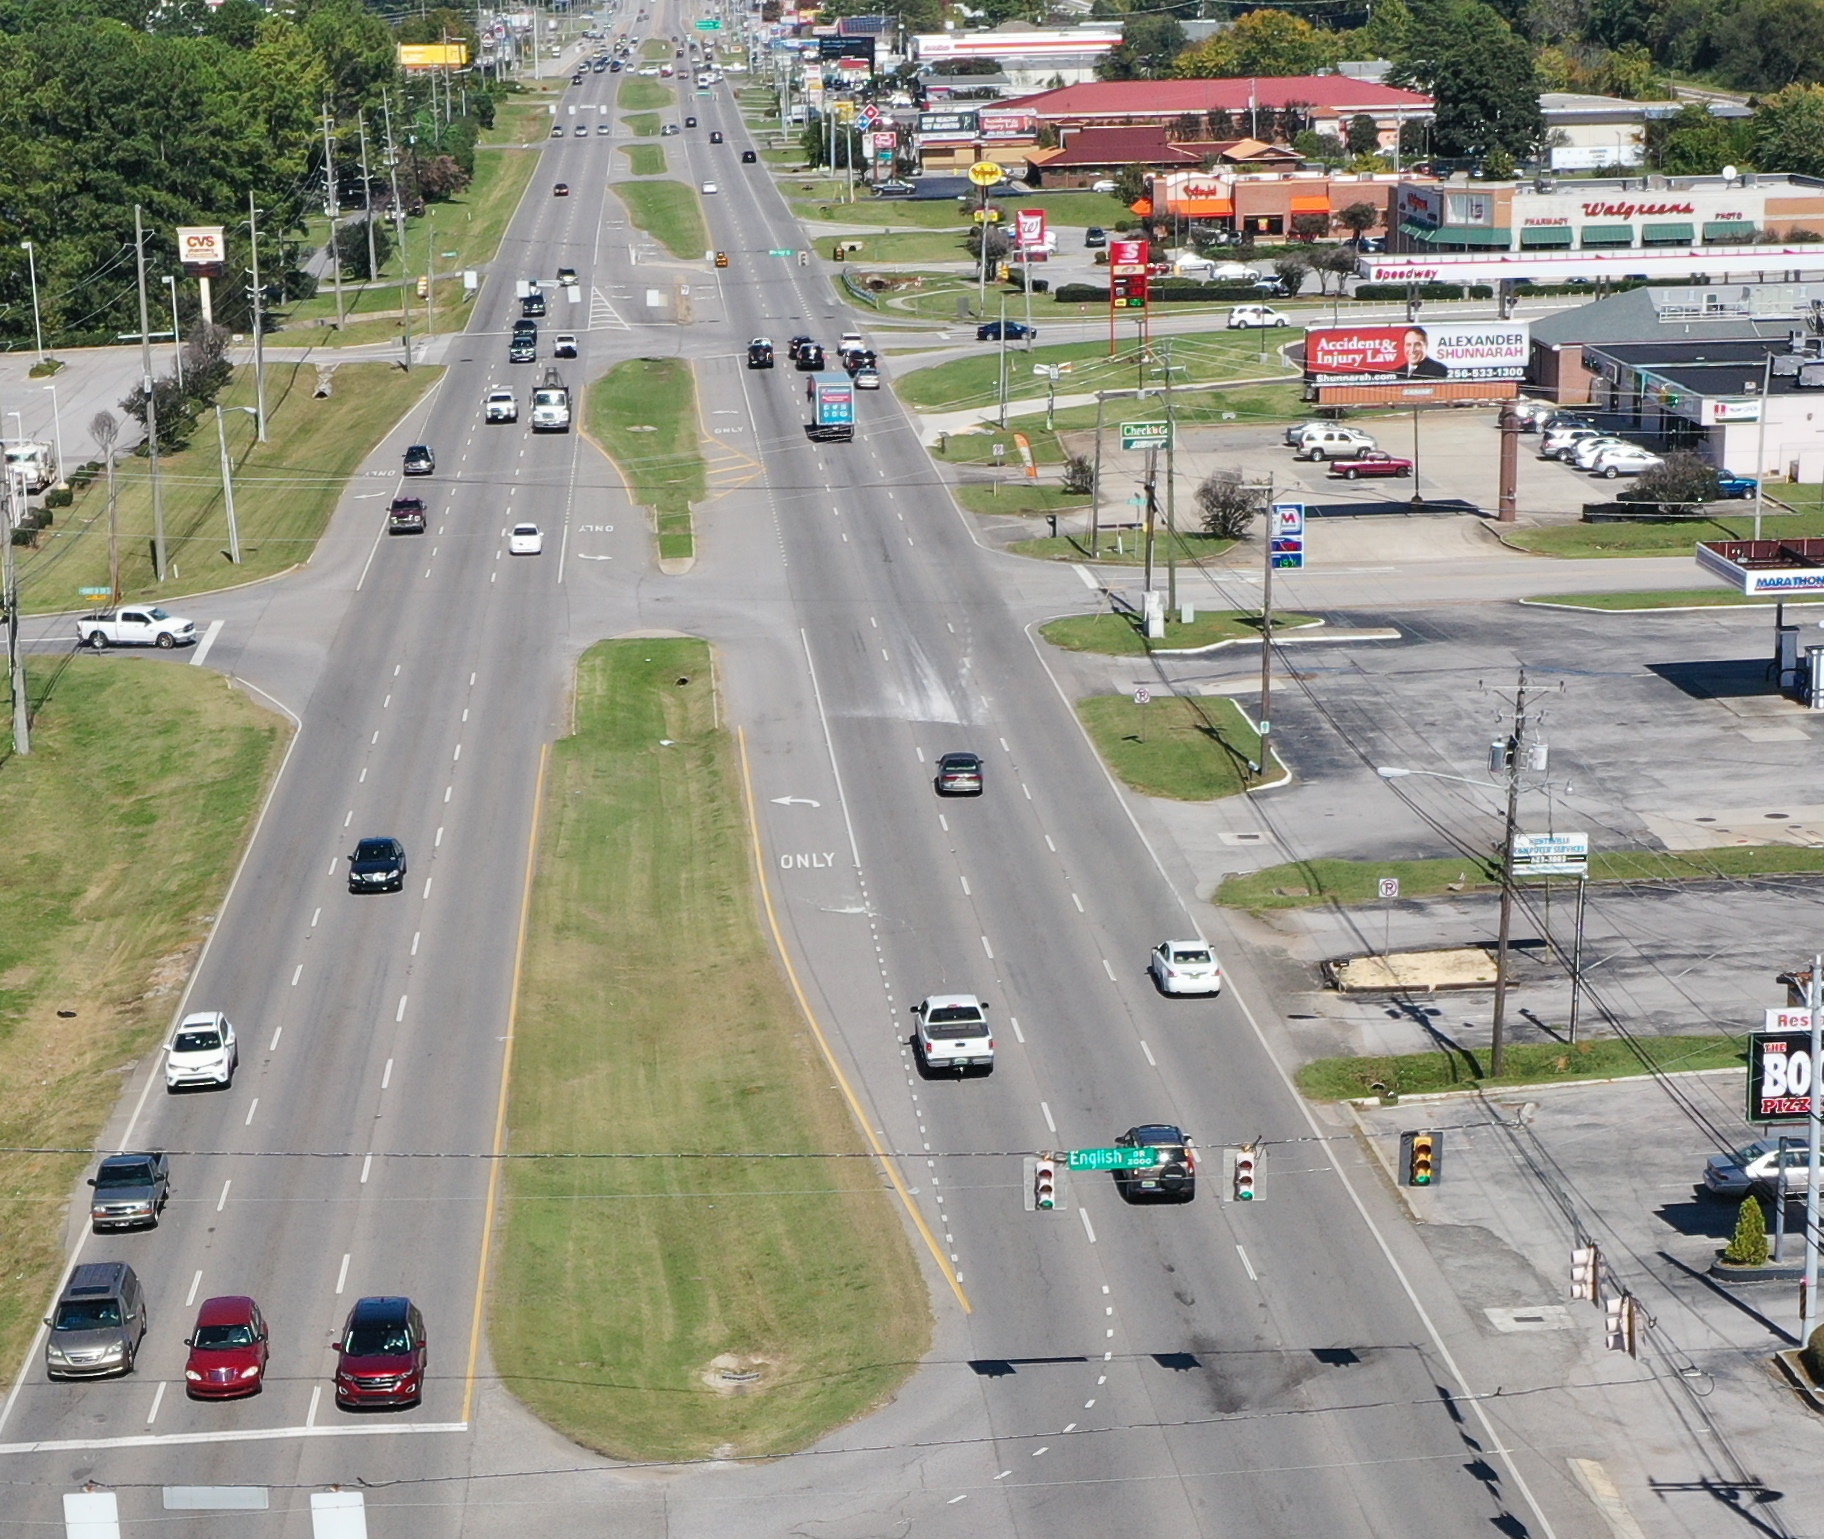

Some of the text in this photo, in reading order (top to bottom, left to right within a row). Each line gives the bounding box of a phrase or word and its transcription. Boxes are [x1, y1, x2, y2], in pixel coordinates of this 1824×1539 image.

[1582, 201, 1694, 221] Walgreens
[1714, 212, 1743, 221] PHOTO
[1524, 217, 1568, 226] PHARMACY
[187, 235, 215, 248] CVS
[1375, 268, 1439, 283] Speedway
[1437, 333, 1523, 348] ALEXANDER
[1316, 350, 1397, 367] Injury Law
[1436, 347, 1523, 360] SHUNNARAH
[1316, 372, 1397, 383] Shunnarah.com
[1446, 367, 1524, 379] 256-533-1300
[714, 426, 743, 434] ONLY
[1123, 424, 1152, 436] Check
[1756, 576, 1824, 588] MARATHON
[780, 852, 836, 869] ONLY
[1763, 1042, 1787, 1053] THE
[1070, 1148, 1145, 1169] English DR
[1126, 1157, 1152, 1165] 2000
